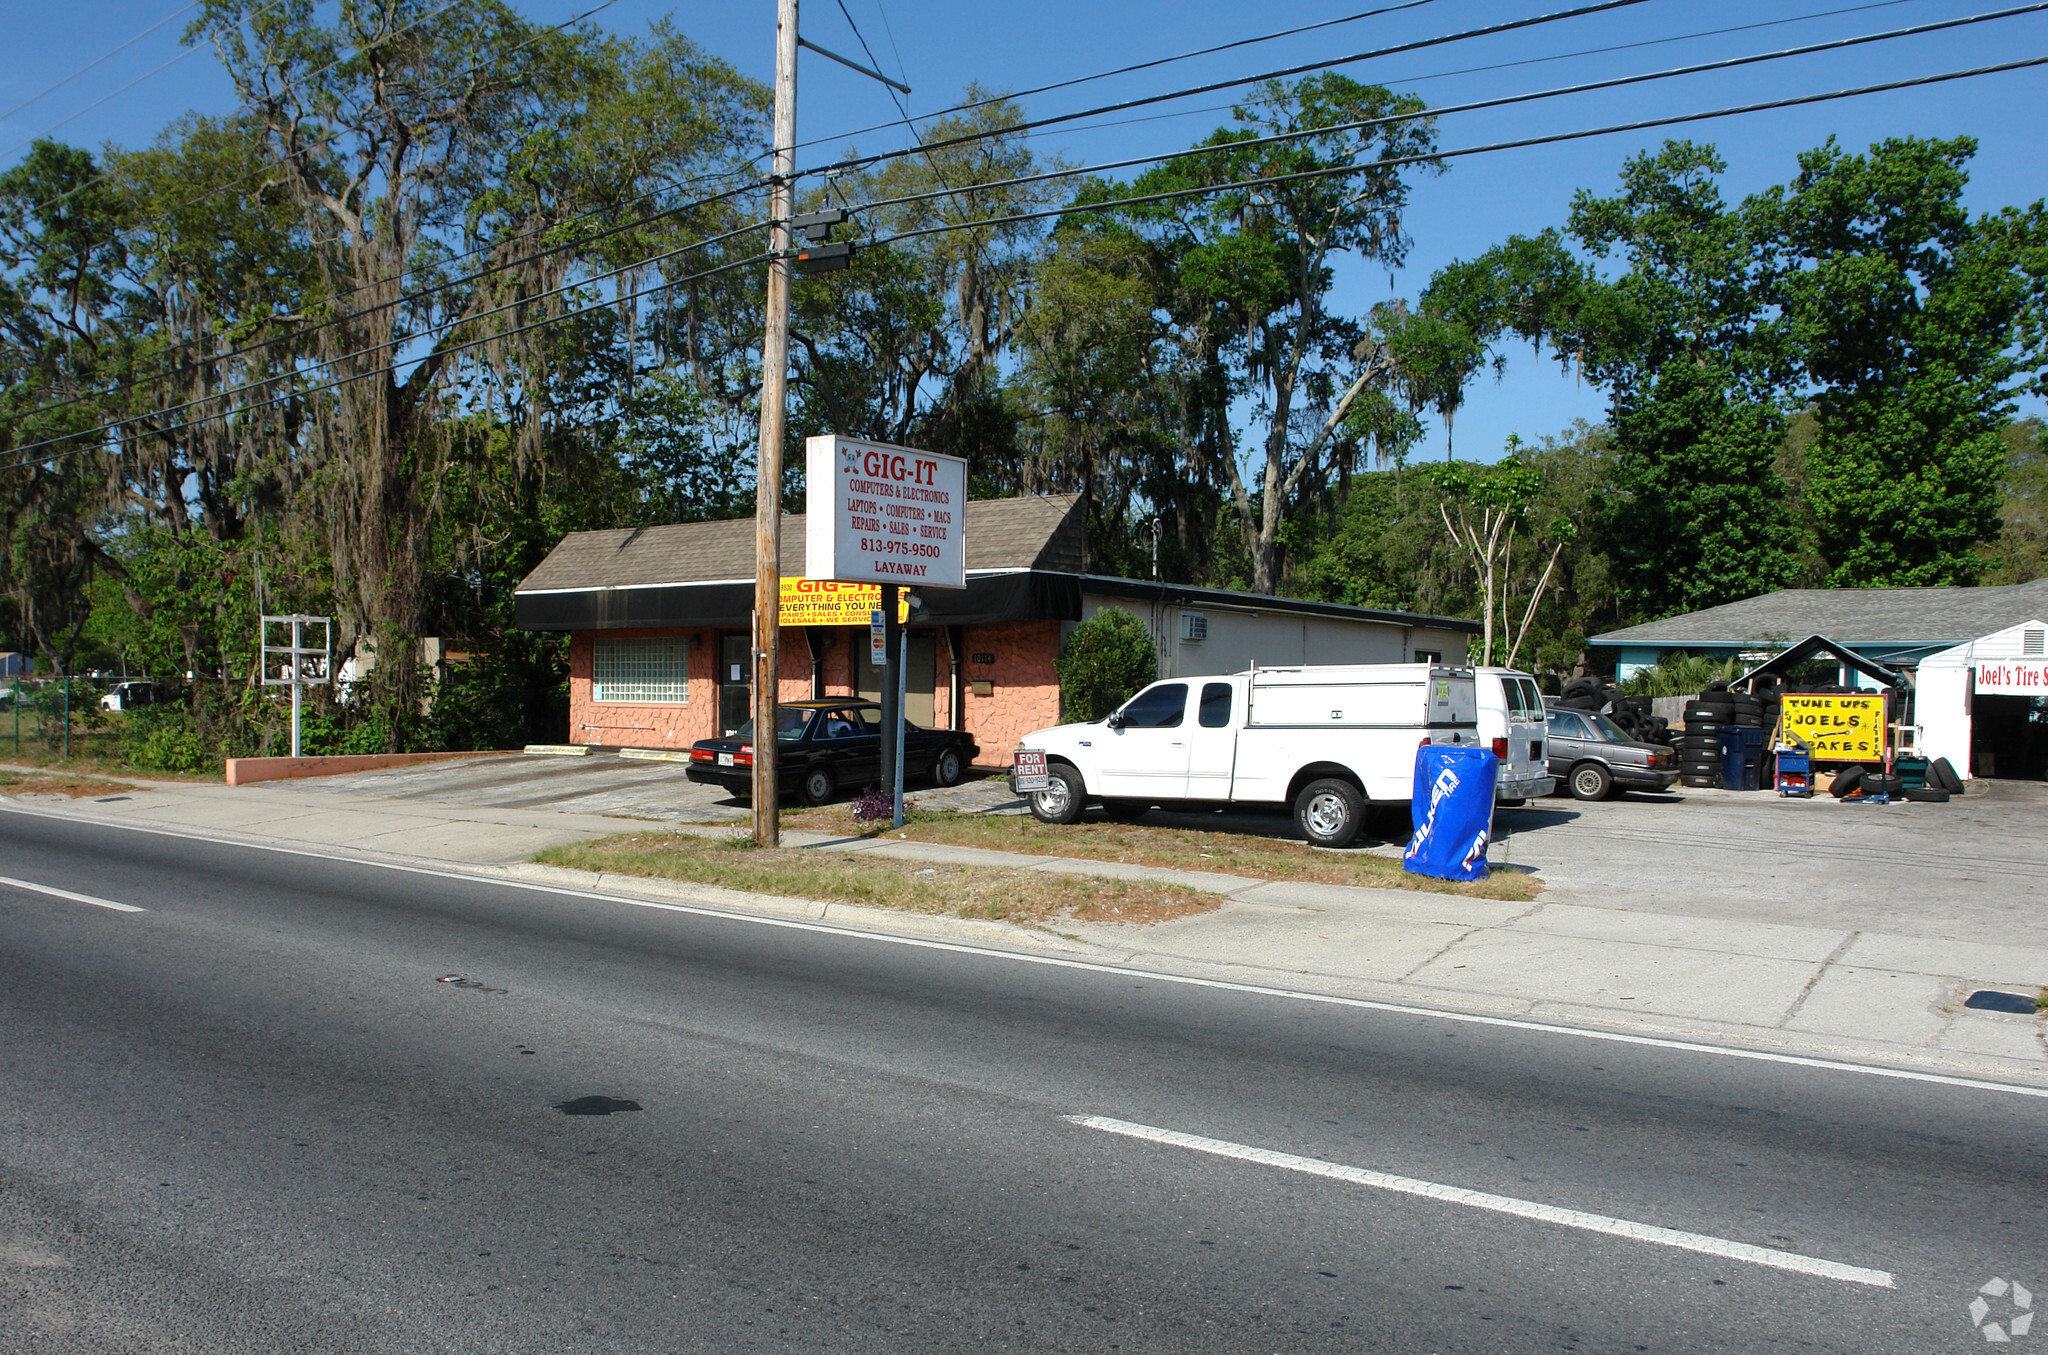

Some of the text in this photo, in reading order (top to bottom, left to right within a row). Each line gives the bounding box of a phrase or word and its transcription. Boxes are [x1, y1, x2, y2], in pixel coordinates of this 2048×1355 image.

[864, 451, 938, 486] GIG-IT
[850, 479, 950, 505] COMPUTERS & ELECTRONICS
[848, 498, 952, 524] LAPTOPS COMPUTERS MACS
[851, 516, 947, 540] REPAIRS SALES SERVICE
[860, 538, 941, 559] 813-975-9500
[875, 560, 928, 577] LAYAWAY
[780, 601, 882, 612] EVERYTHING YOU NE
[826, 594, 834, 602] &
[1979, 664, 2011, 686] Joel's
[2015, 665, 2039, 686] Tire
[1789, 699, 1870, 710] TUNE UPS
[1794, 715, 1861, 727] JOELS
[1019, 753, 1041, 764] FOR
[1017, 764, 1045, 775] RENT
[1443, 777, 1461, 798] TIRE
